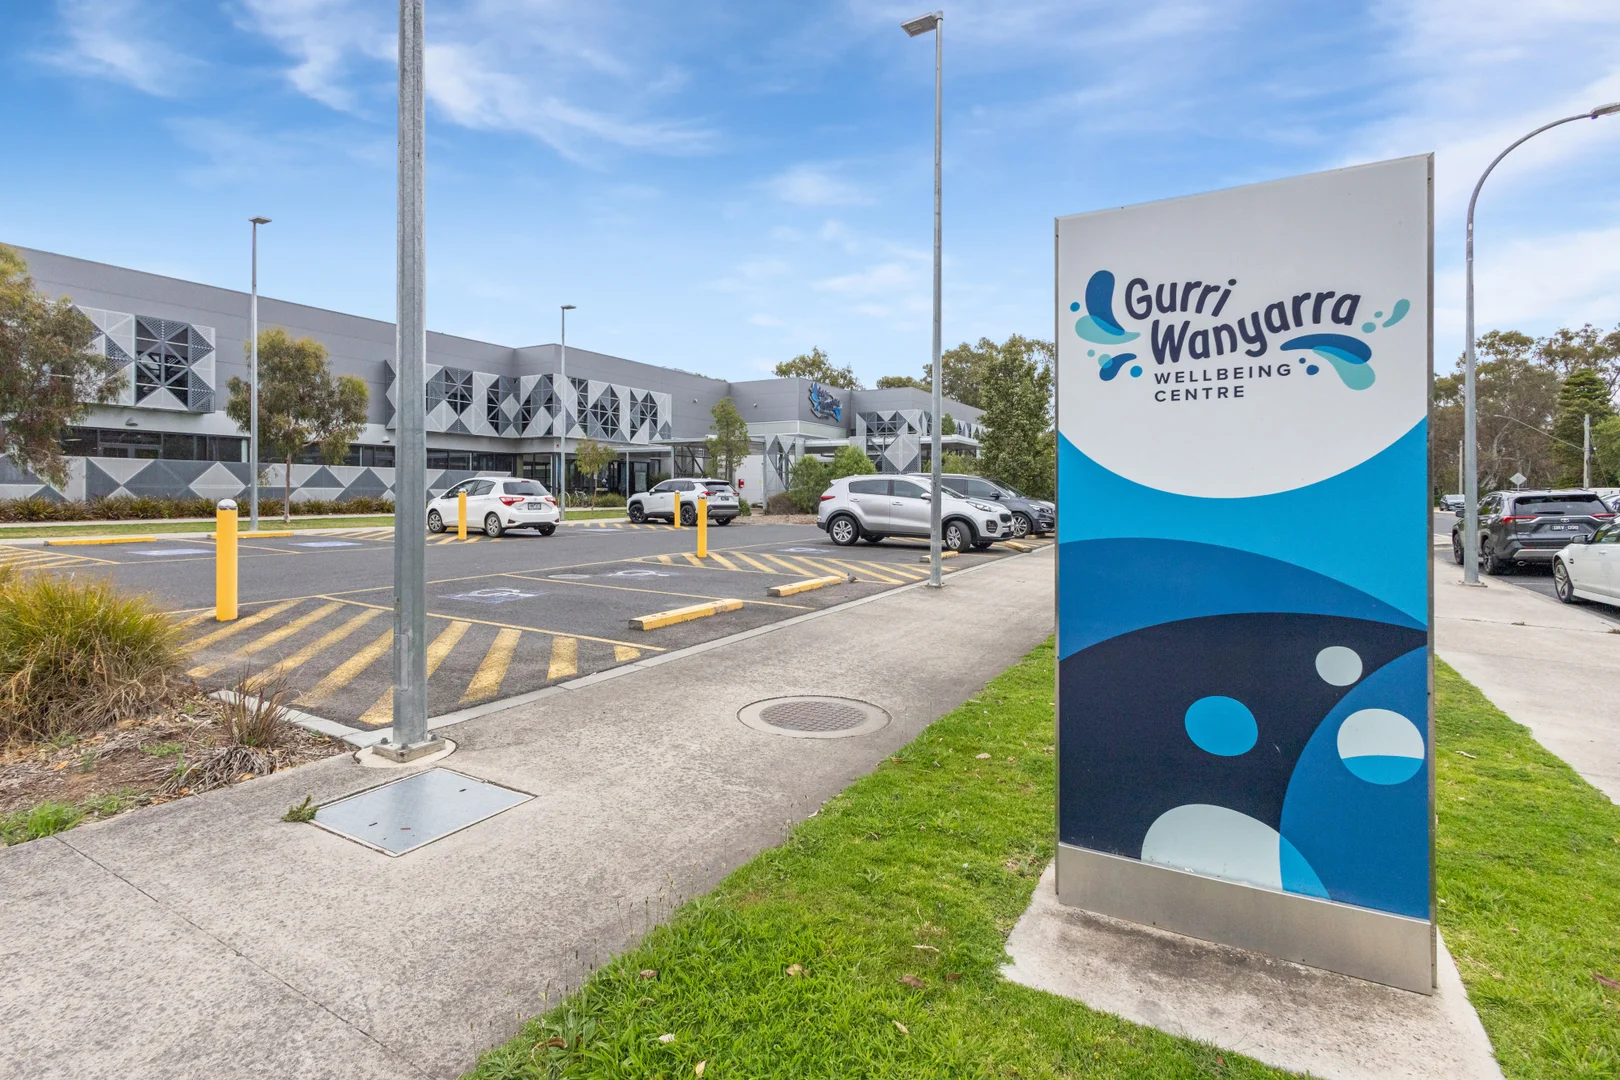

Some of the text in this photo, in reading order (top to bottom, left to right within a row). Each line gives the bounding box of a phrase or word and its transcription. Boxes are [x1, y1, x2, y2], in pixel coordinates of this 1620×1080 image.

[1124, 277, 1237, 320] Gurri
[1150, 290, 1362, 365] Wanyarra
[1154, 363, 1291, 385] WELLBEING
[1154, 385, 1245, 402] CENTRE
